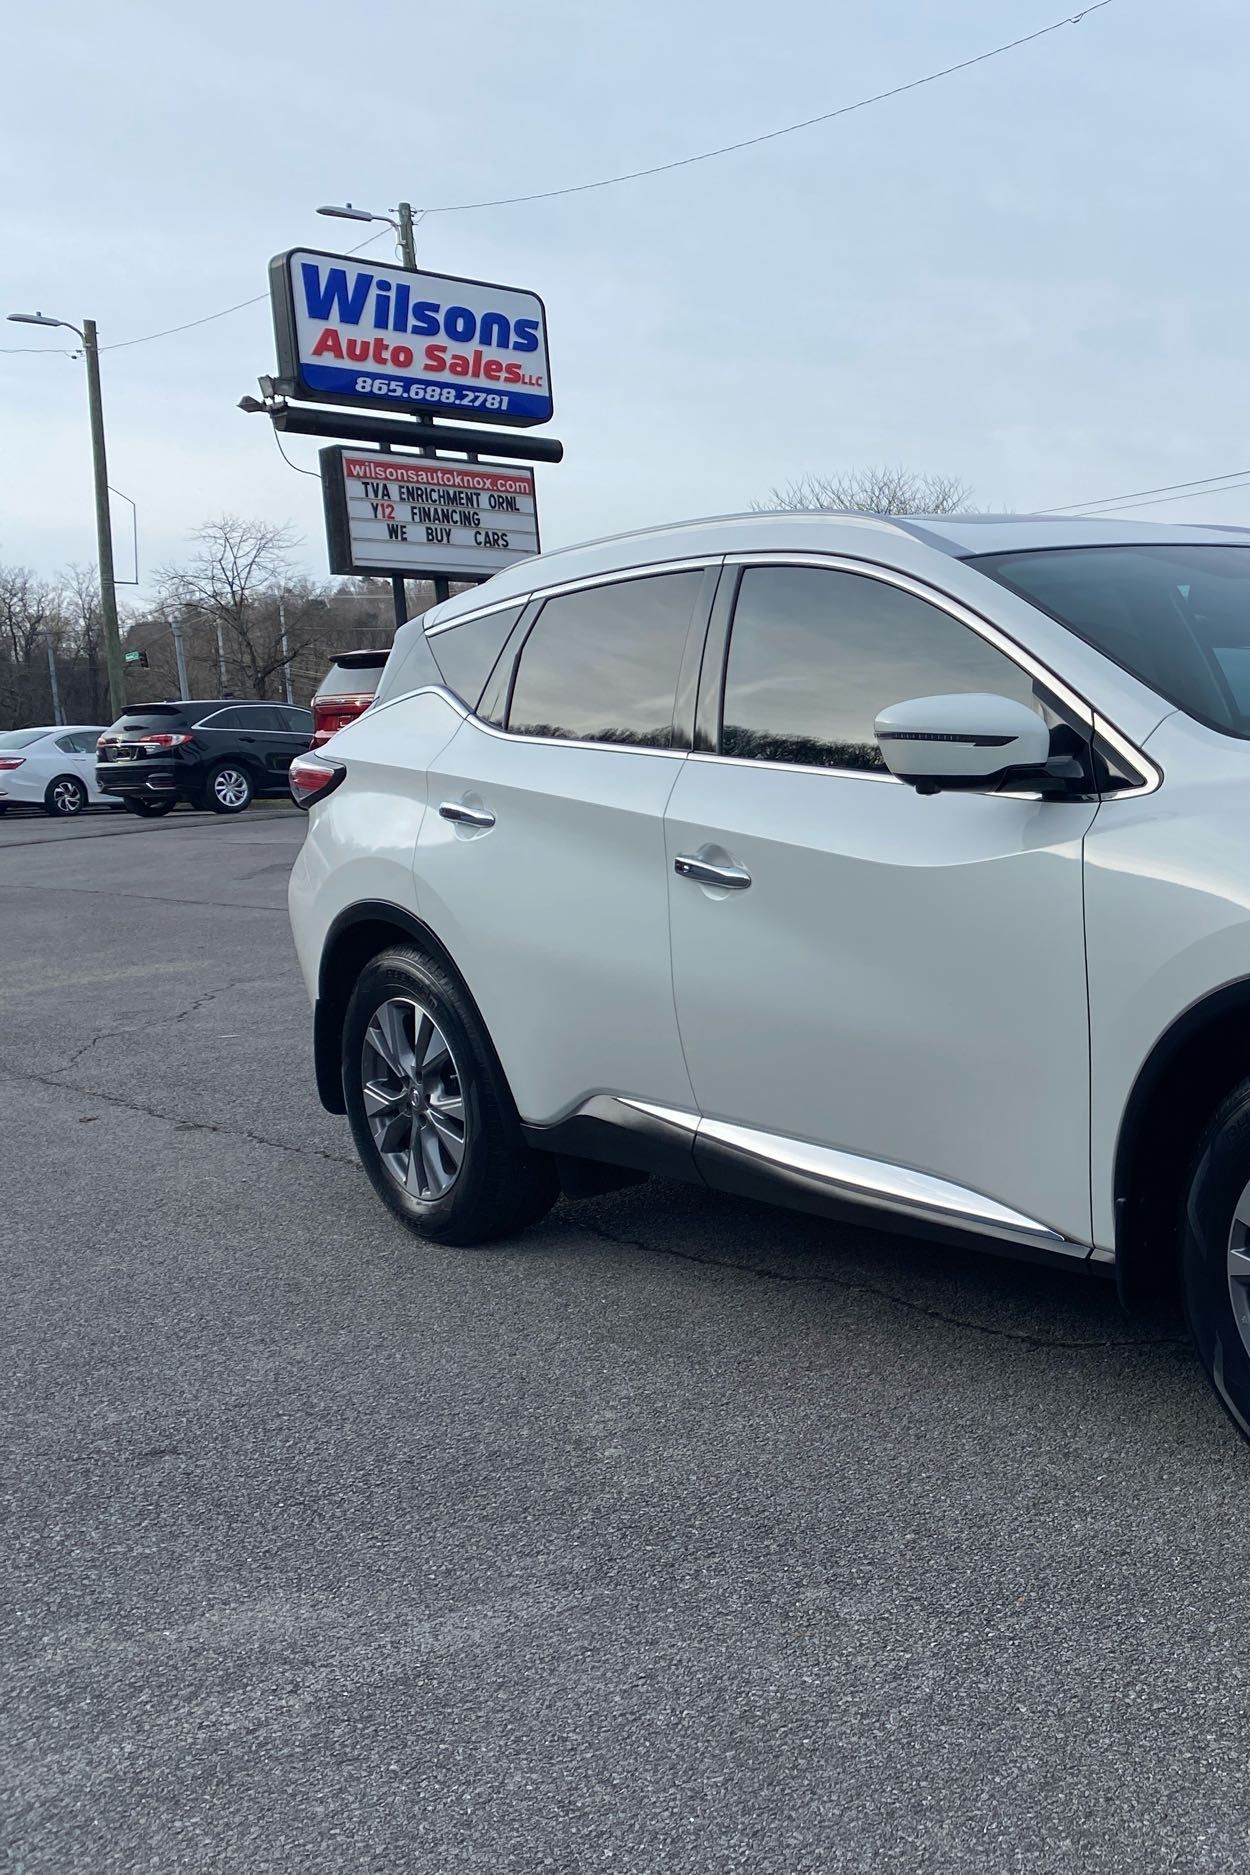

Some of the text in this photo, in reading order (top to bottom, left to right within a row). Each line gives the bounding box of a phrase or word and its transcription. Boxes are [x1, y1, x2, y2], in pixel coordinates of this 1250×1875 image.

[301, 262, 540, 352] Wilsons
[312, 328, 543, 387] Auto Sales LLC
[355, 377, 509, 410] 865.688.2781
[350, 463, 530, 493] wilsonsautoknox.com
[362, 482, 520, 511] TVA ENRICHMENT ORNL
[371, 502, 481, 526] Y12 FINANCING
[387, 524, 509, 548] WE BUY CARS
